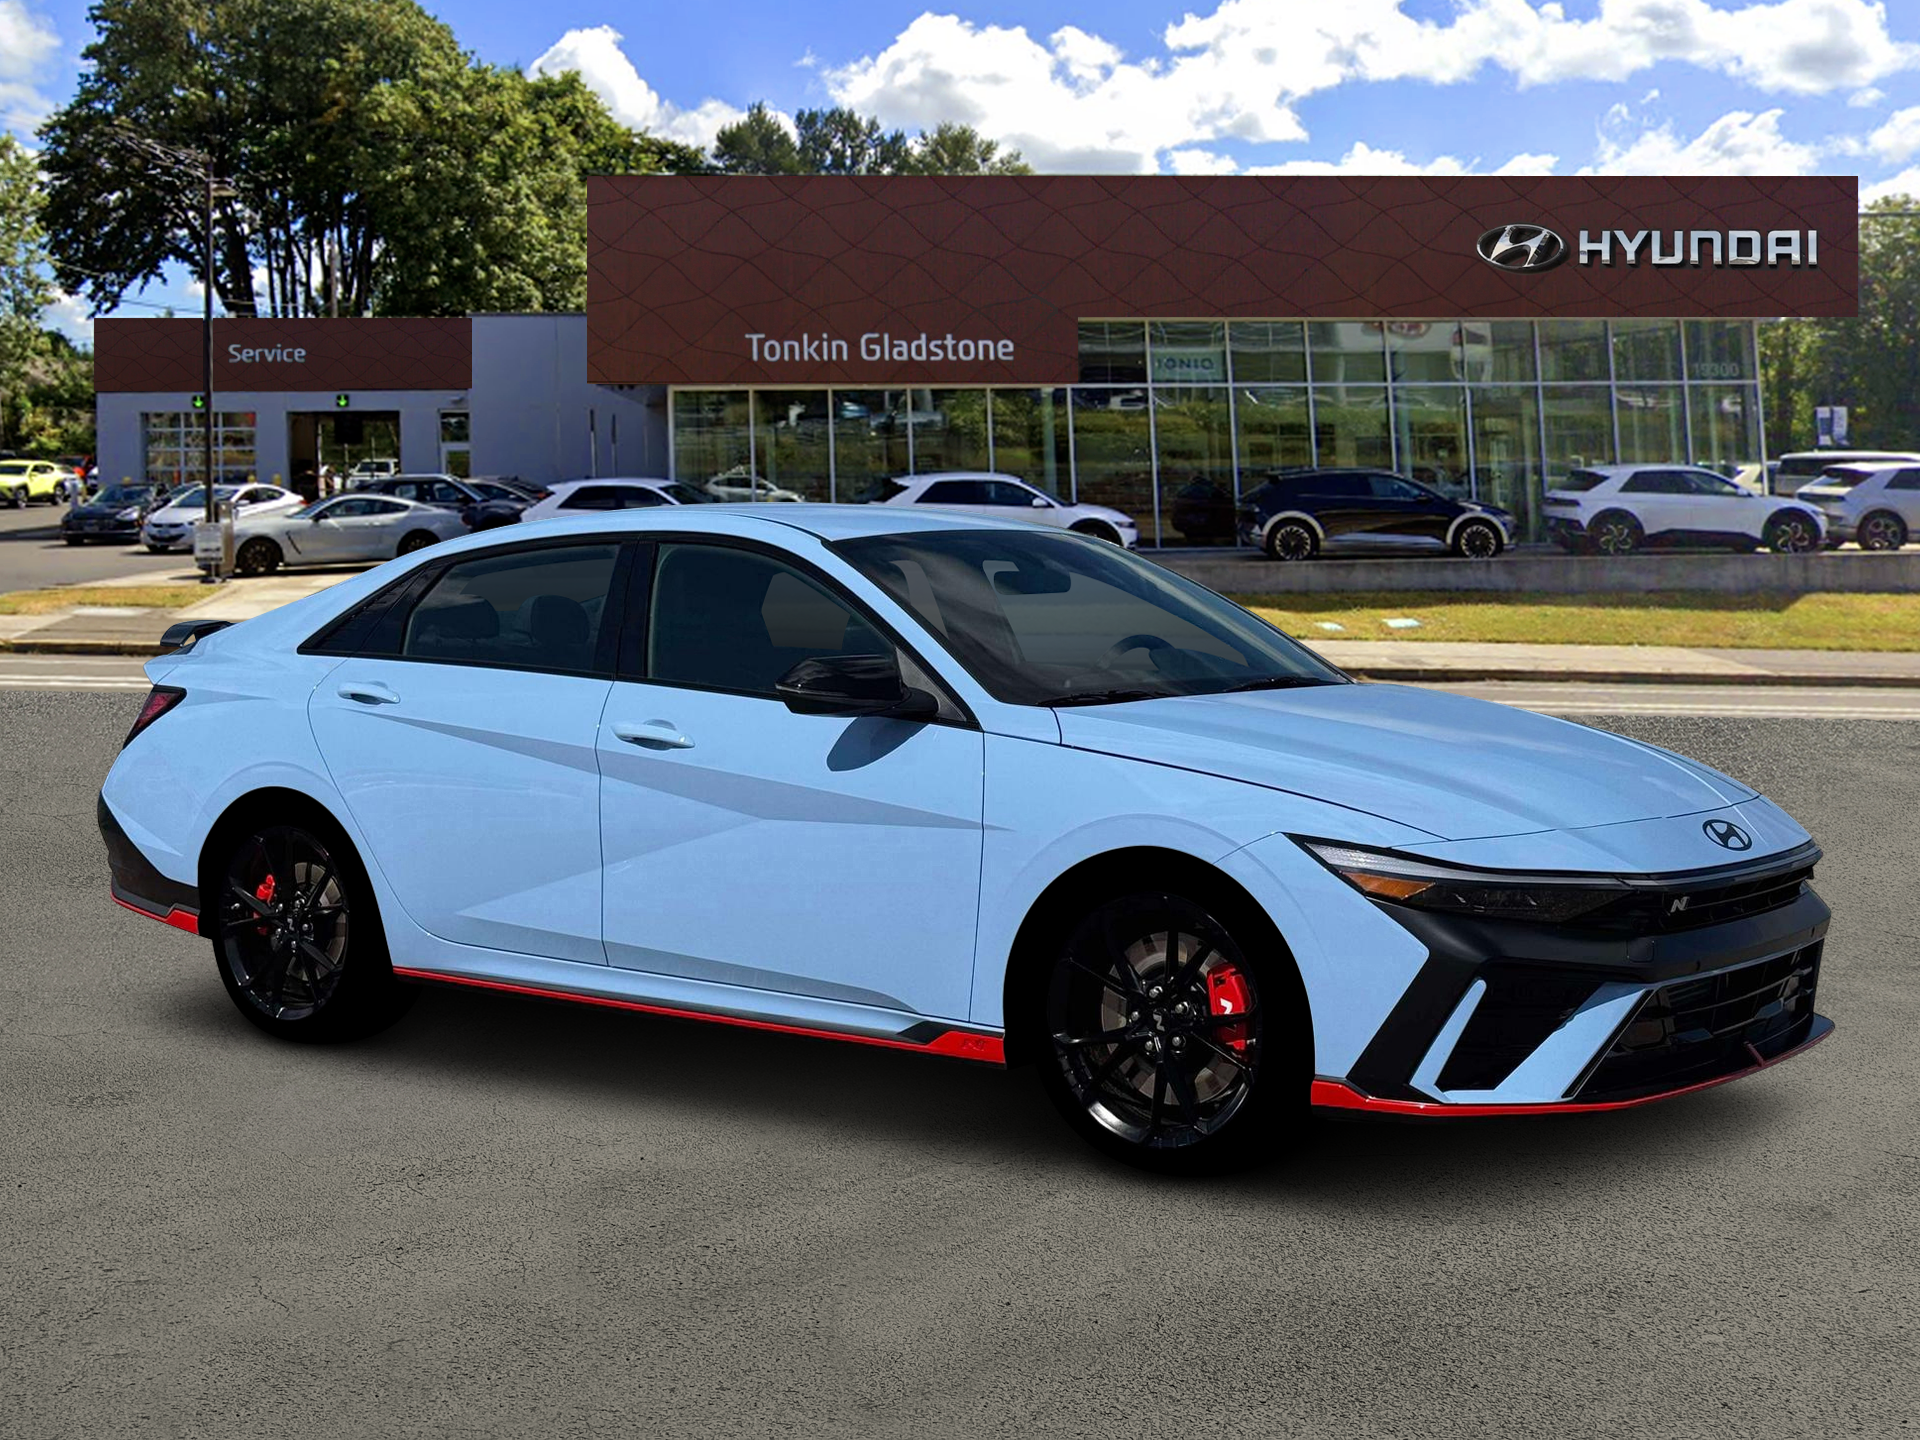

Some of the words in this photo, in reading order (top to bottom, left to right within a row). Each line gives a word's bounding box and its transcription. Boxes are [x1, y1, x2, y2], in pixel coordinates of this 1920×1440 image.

[1578, 229, 1818, 266] HYUNDAI
[227, 343, 307, 363] Service
[744, 332, 848, 362] Tonkin
[860, 332, 1015, 362] Gladstone
[1157, 357, 1215, 370] IONIQ
[1670, 896, 1690, 913] N
